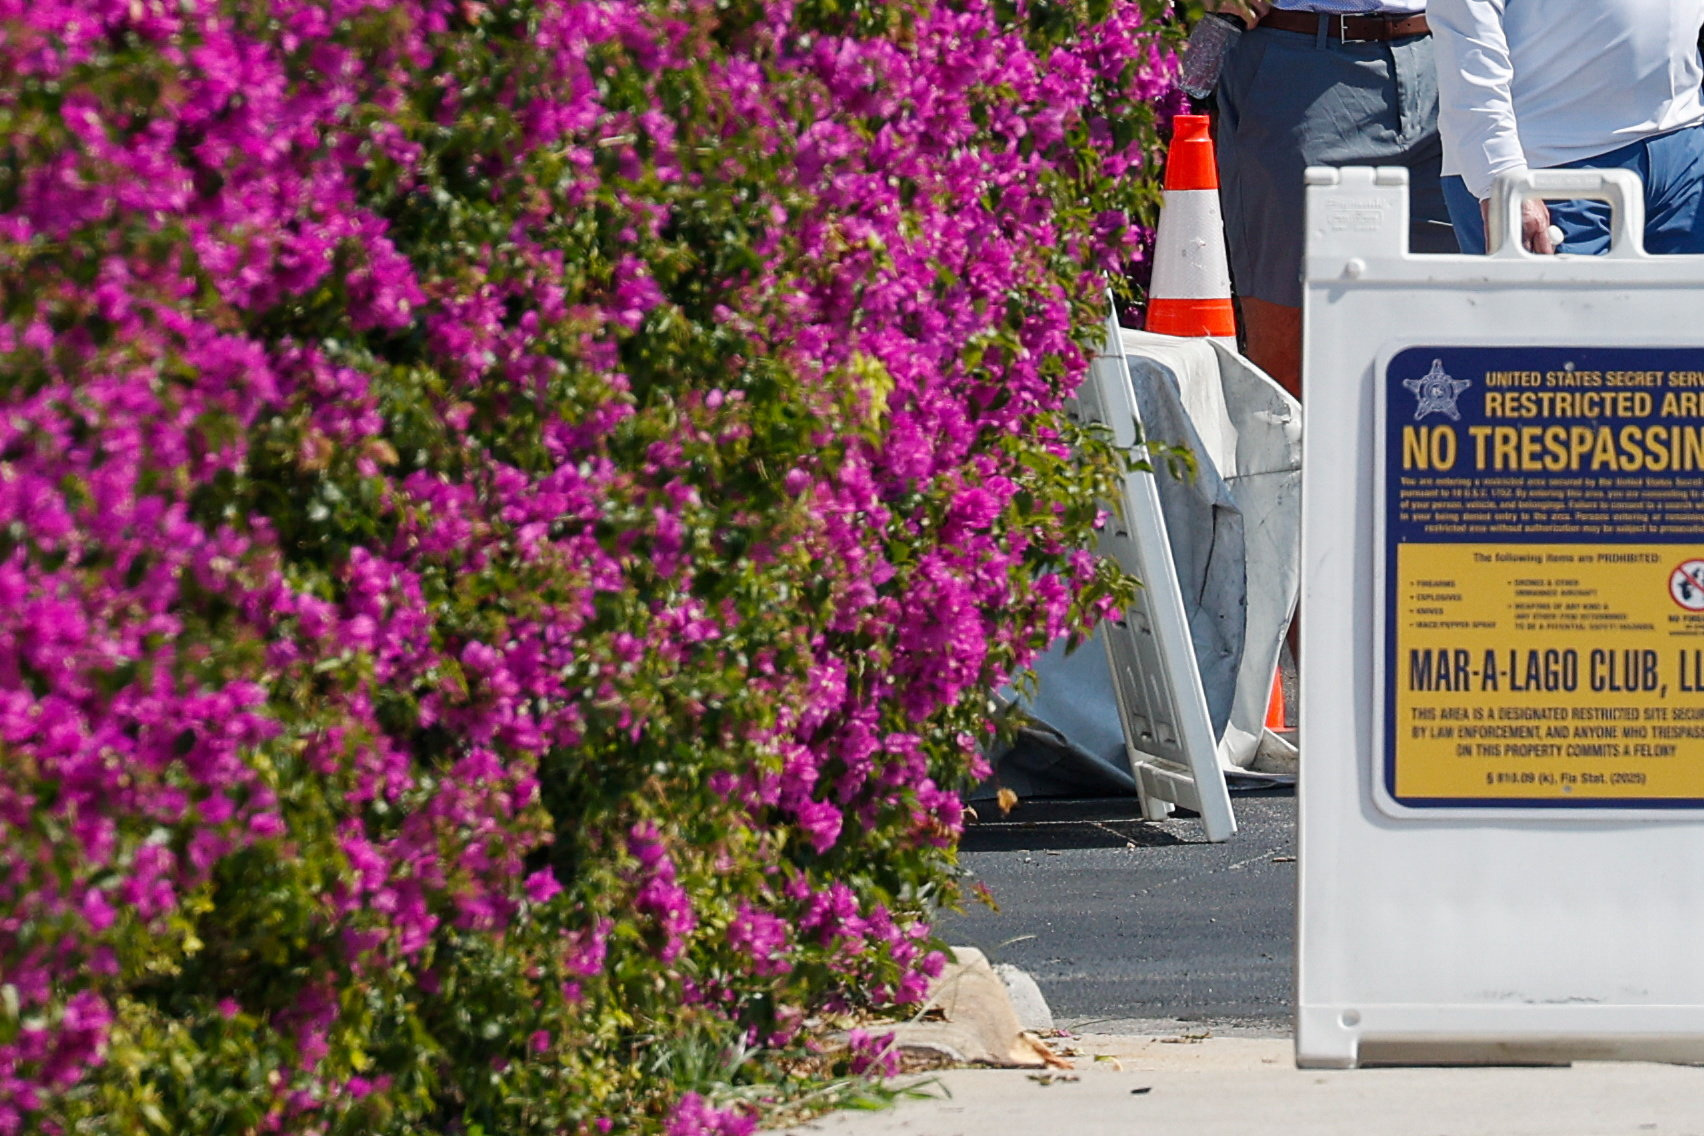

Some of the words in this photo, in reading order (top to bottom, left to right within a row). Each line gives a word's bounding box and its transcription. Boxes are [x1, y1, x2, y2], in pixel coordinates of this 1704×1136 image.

[1485, 370, 1542, 388] UNITED
[1545, 370, 1603, 388] STATES
[1605, 370, 1665, 388] SECRET
[1485, 391, 1653, 419] RESTRICTED
[1402, 424, 1457, 472] NO
[1473, 552, 1492, 562] The
[1495, 552, 1544, 564] following
[1546, 552, 1575, 562] items
[1578, 552, 1594, 562] are
[1409, 648, 1579, 693] MAR-A-LAGO
[1589, 648, 1668, 699] CLUB,
[1411, 707, 1436, 721] THIS
[1440, 707, 1470, 721] AREA
[1473, 707, 1484, 721] IS
[1487, 707, 1495, 721] A
[1499, 707, 1569, 721] DESIGNATED
[1571, 707, 1640, 721] RESTRICTED
[1643, 707, 1668, 721] SITE
[1412, 725, 1426, 739] BY
[1430, 725, 1453, 739] LAW
[1457, 725, 1543, 740] ENFORCEMENT,
[1545, 725, 1570, 739] AND
[1573, 725, 1618, 739] ANYONE
[1622, 725, 1648, 739] WHO
[1456, 743, 1472, 757] ON
[1476, 743, 1502, 757] THIS
[1504, 743, 1562, 757] PROPERTY
[1566, 743, 1620, 757] COMMITS
[1623, 743, 1631, 757] A
[1633, 743, 1677, 757] FELONY
